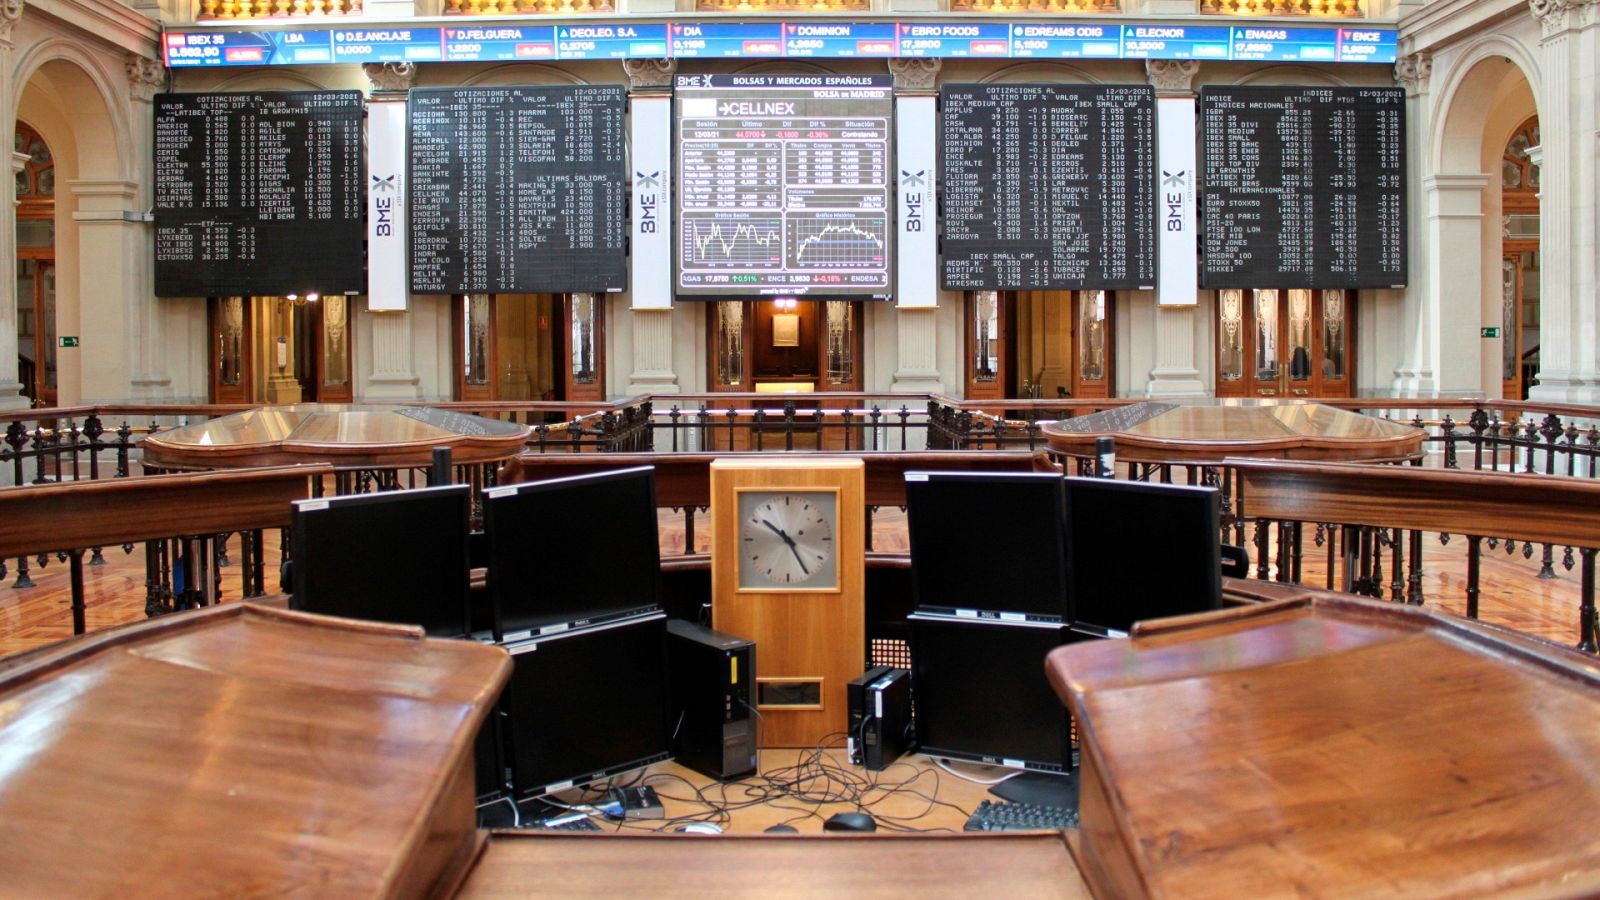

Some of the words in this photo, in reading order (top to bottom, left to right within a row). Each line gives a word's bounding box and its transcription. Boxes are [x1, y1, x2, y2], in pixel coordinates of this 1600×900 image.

[457, 30, 522, 40] D.FELGUERA
[618, 28, 638, 37] S.A.
[684, 27, 702, 36] DIA
[798, 27, 849, 36] DOMINION
[912, 27, 941, 36] EBRO
[943, 27, 980, 36] FOODS
[1025, 28, 1075, 37] EDREAMS
[1077, 28, 1103, 37] ODIG
[1136, 28, 1184, 38] ELECNOR
[1246, 30, 1286, 40] ENAGAS
[188, 36, 211, 44] IBEX
[213, 35, 224, 44] 35
[346, 32, 411, 42] D.E.ANCLAJE
[1353, 32, 1380, 42] ENCE
[678, 77, 700, 86] BME
[826, 76, 872, 85] ESPAÑOLES
[730, 103, 794, 115] CELLNEX
[641, 194, 655, 233] BME
[906, 192, 921, 232] BME
[1168, 192, 1182, 231] BME
[376, 198, 391, 236] BME
